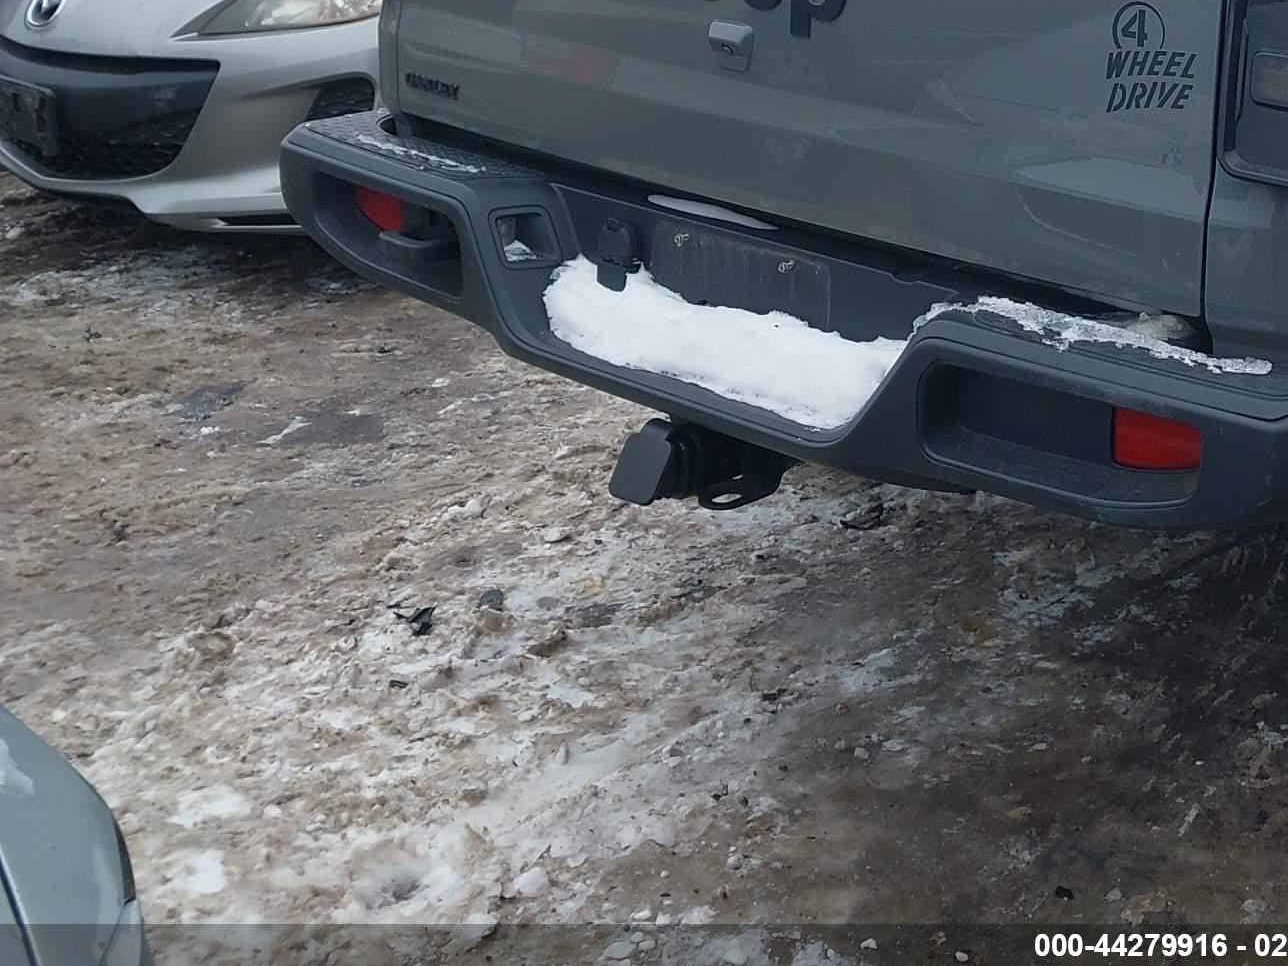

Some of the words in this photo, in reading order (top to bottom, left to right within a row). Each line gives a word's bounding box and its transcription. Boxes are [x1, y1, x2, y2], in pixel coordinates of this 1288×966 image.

[1120, 9, 1148, 48] 4
[1105, 50, 1198, 80] WHEEL
[1105, 81, 1195, 113] DRIVE
